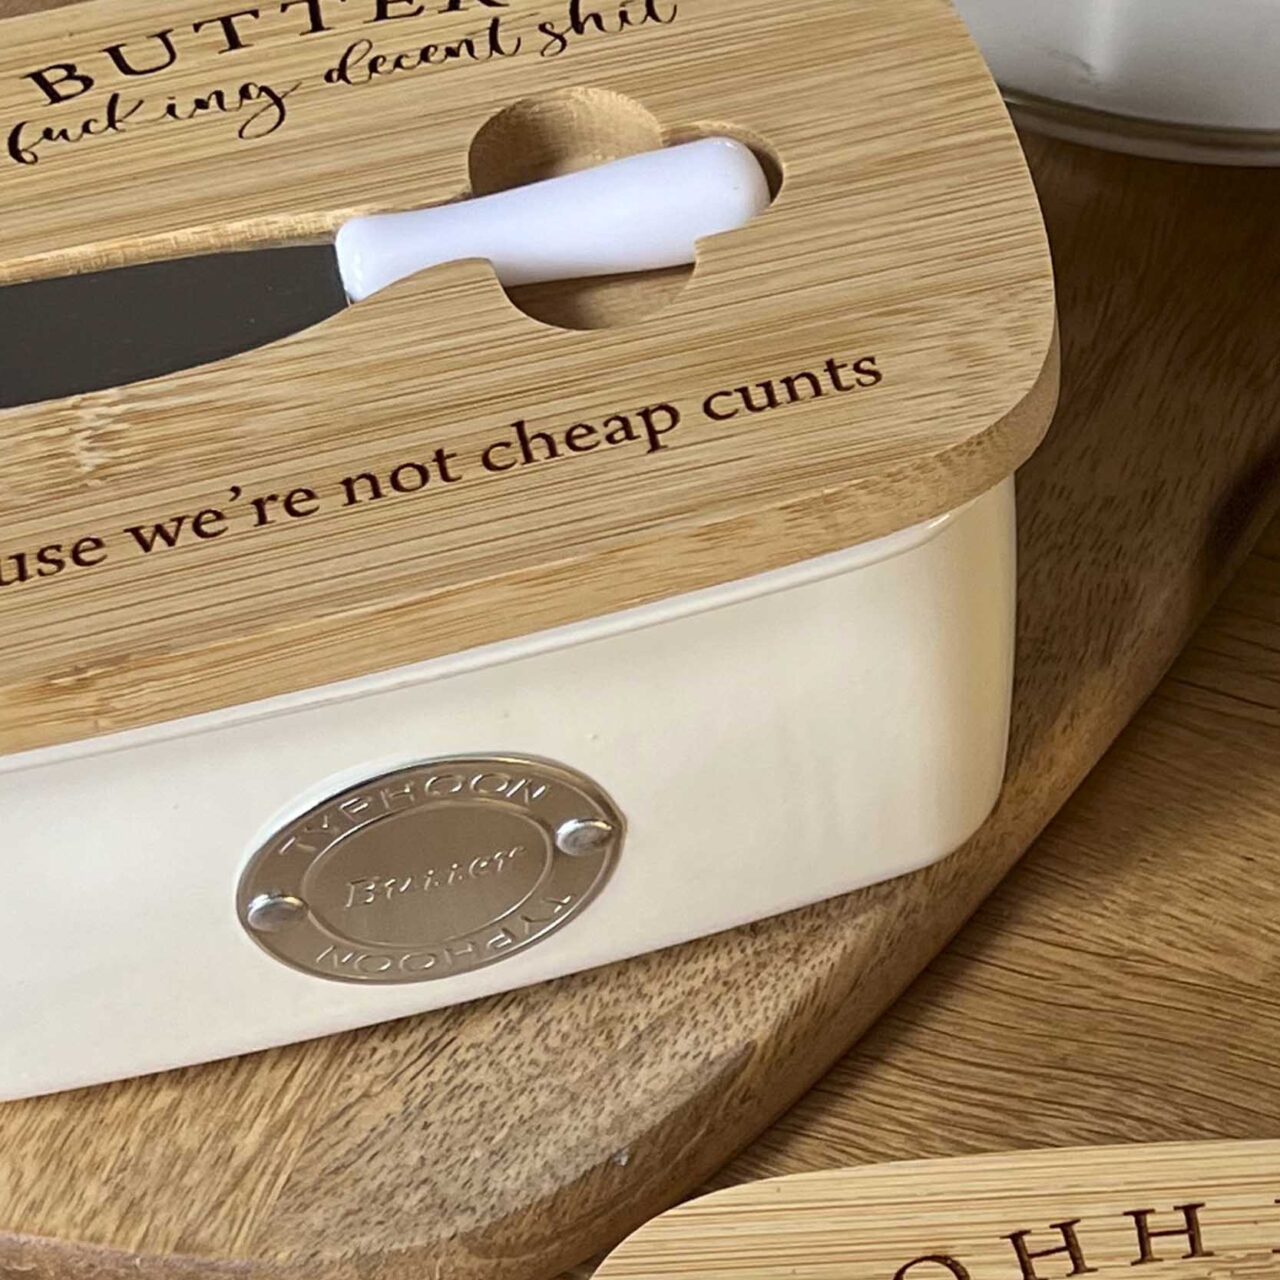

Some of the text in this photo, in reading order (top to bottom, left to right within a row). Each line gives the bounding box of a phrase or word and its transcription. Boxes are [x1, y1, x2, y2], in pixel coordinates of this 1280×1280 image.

[322, 16, 522, 86] decent
[340, 446, 464, 508] not
[480, 399, 682, 474] cheap
[701, 354, 884, 422] cunts
